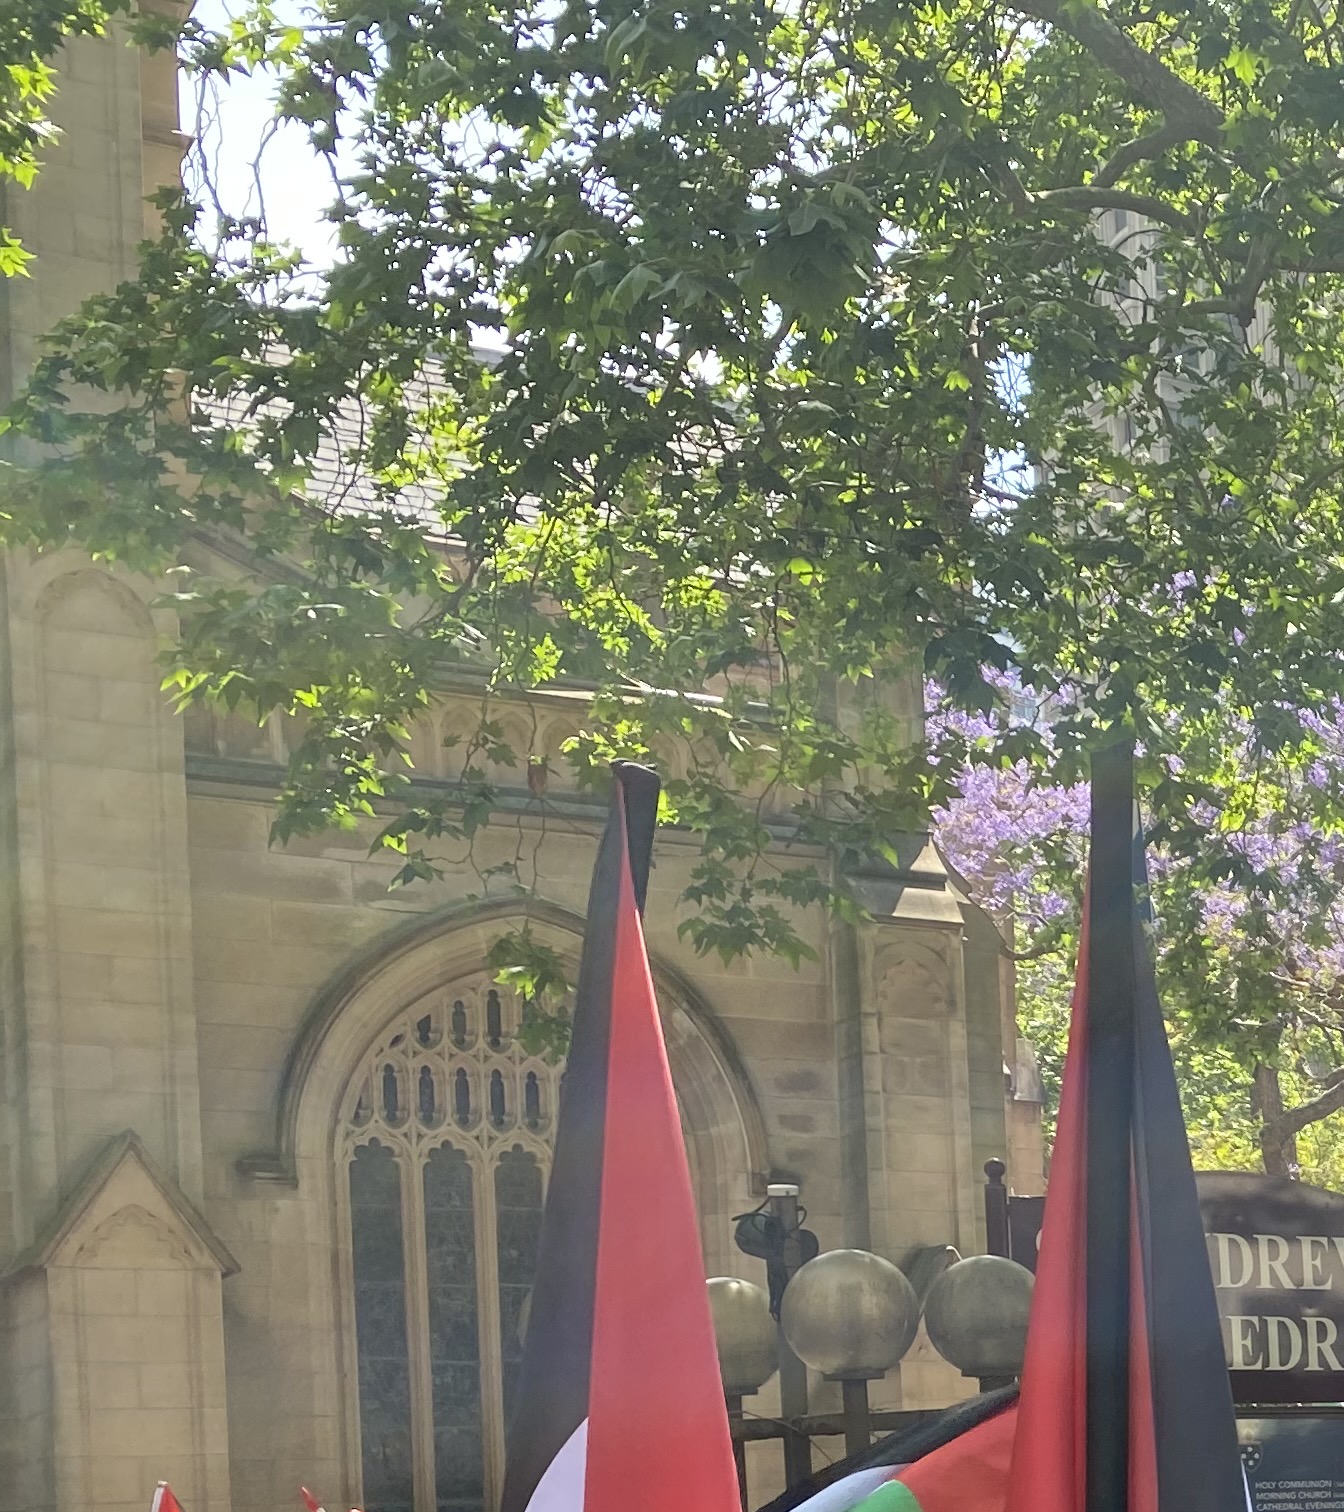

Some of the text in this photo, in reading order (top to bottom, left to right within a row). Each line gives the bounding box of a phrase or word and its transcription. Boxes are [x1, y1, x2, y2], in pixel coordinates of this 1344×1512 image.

[1255, 1481, 1277, 1490] HOLY
[1278, 1479, 1332, 1489] COMMUNION
[1256, 1491, 1297, 1500] MORNING
[1298, 1490, 1332, 1499] CHURCH
[1256, 1501, 1304, 1512] CATHEDRAL
